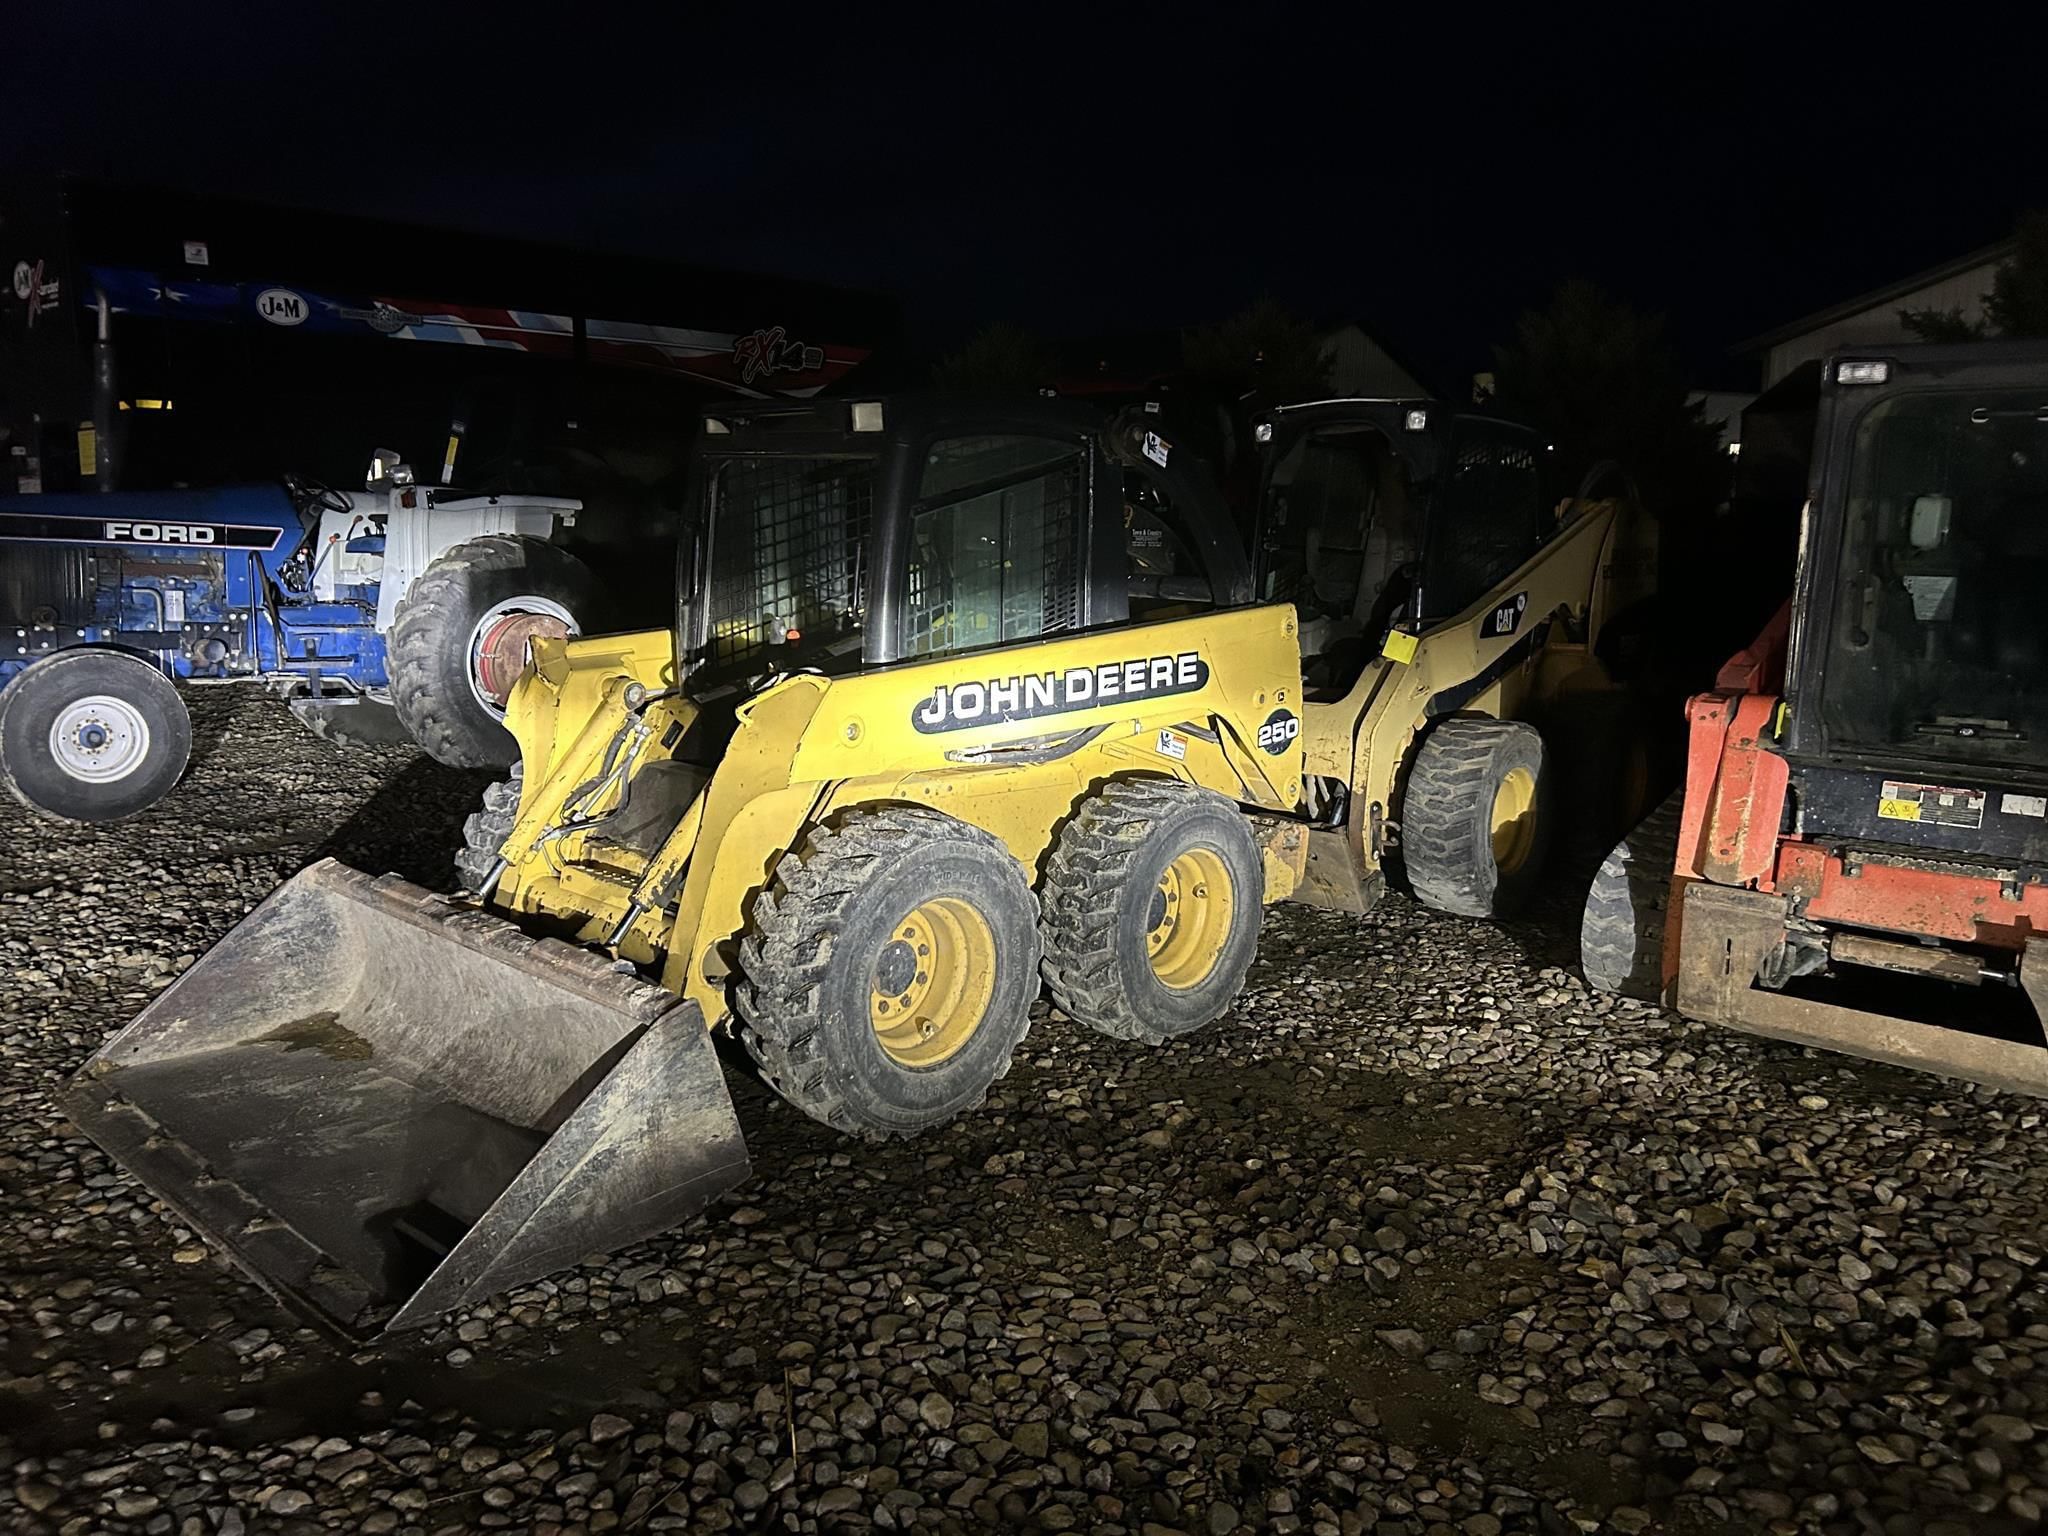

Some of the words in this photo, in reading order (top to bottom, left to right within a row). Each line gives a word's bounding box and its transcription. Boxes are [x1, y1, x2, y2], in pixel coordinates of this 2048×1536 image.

[262, 297, 300, 318] J&M
[106, 522, 215, 544] FORD
[1496, 608, 1514, 632] CAT
[920, 671, 1056, 725] JOHN
[1064, 652, 1200, 703] DEERE
[1258, 718, 1299, 747] 250
